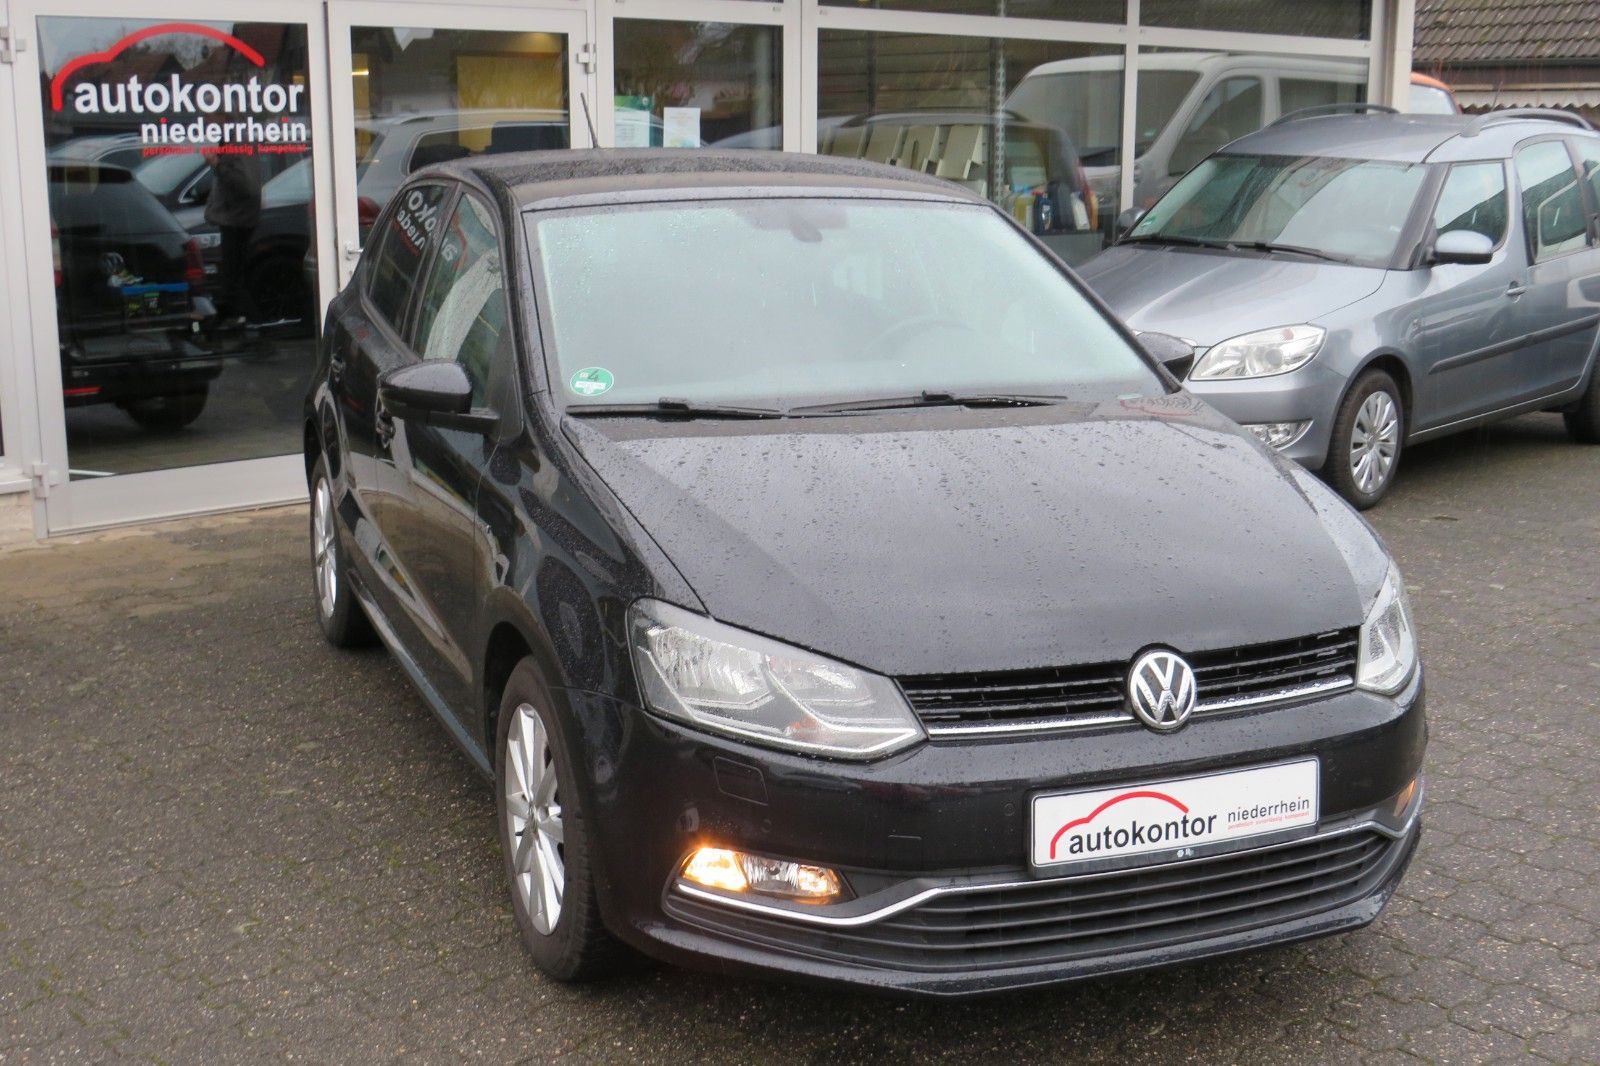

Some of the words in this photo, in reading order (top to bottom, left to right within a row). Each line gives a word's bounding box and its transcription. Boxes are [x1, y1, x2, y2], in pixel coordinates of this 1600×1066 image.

[74, 74, 304, 113] autokontor
[141, 117, 307, 143] niederrhein
[1069, 812, 1217, 854] autokontor
[1227, 797, 1310, 824] niederrhein
